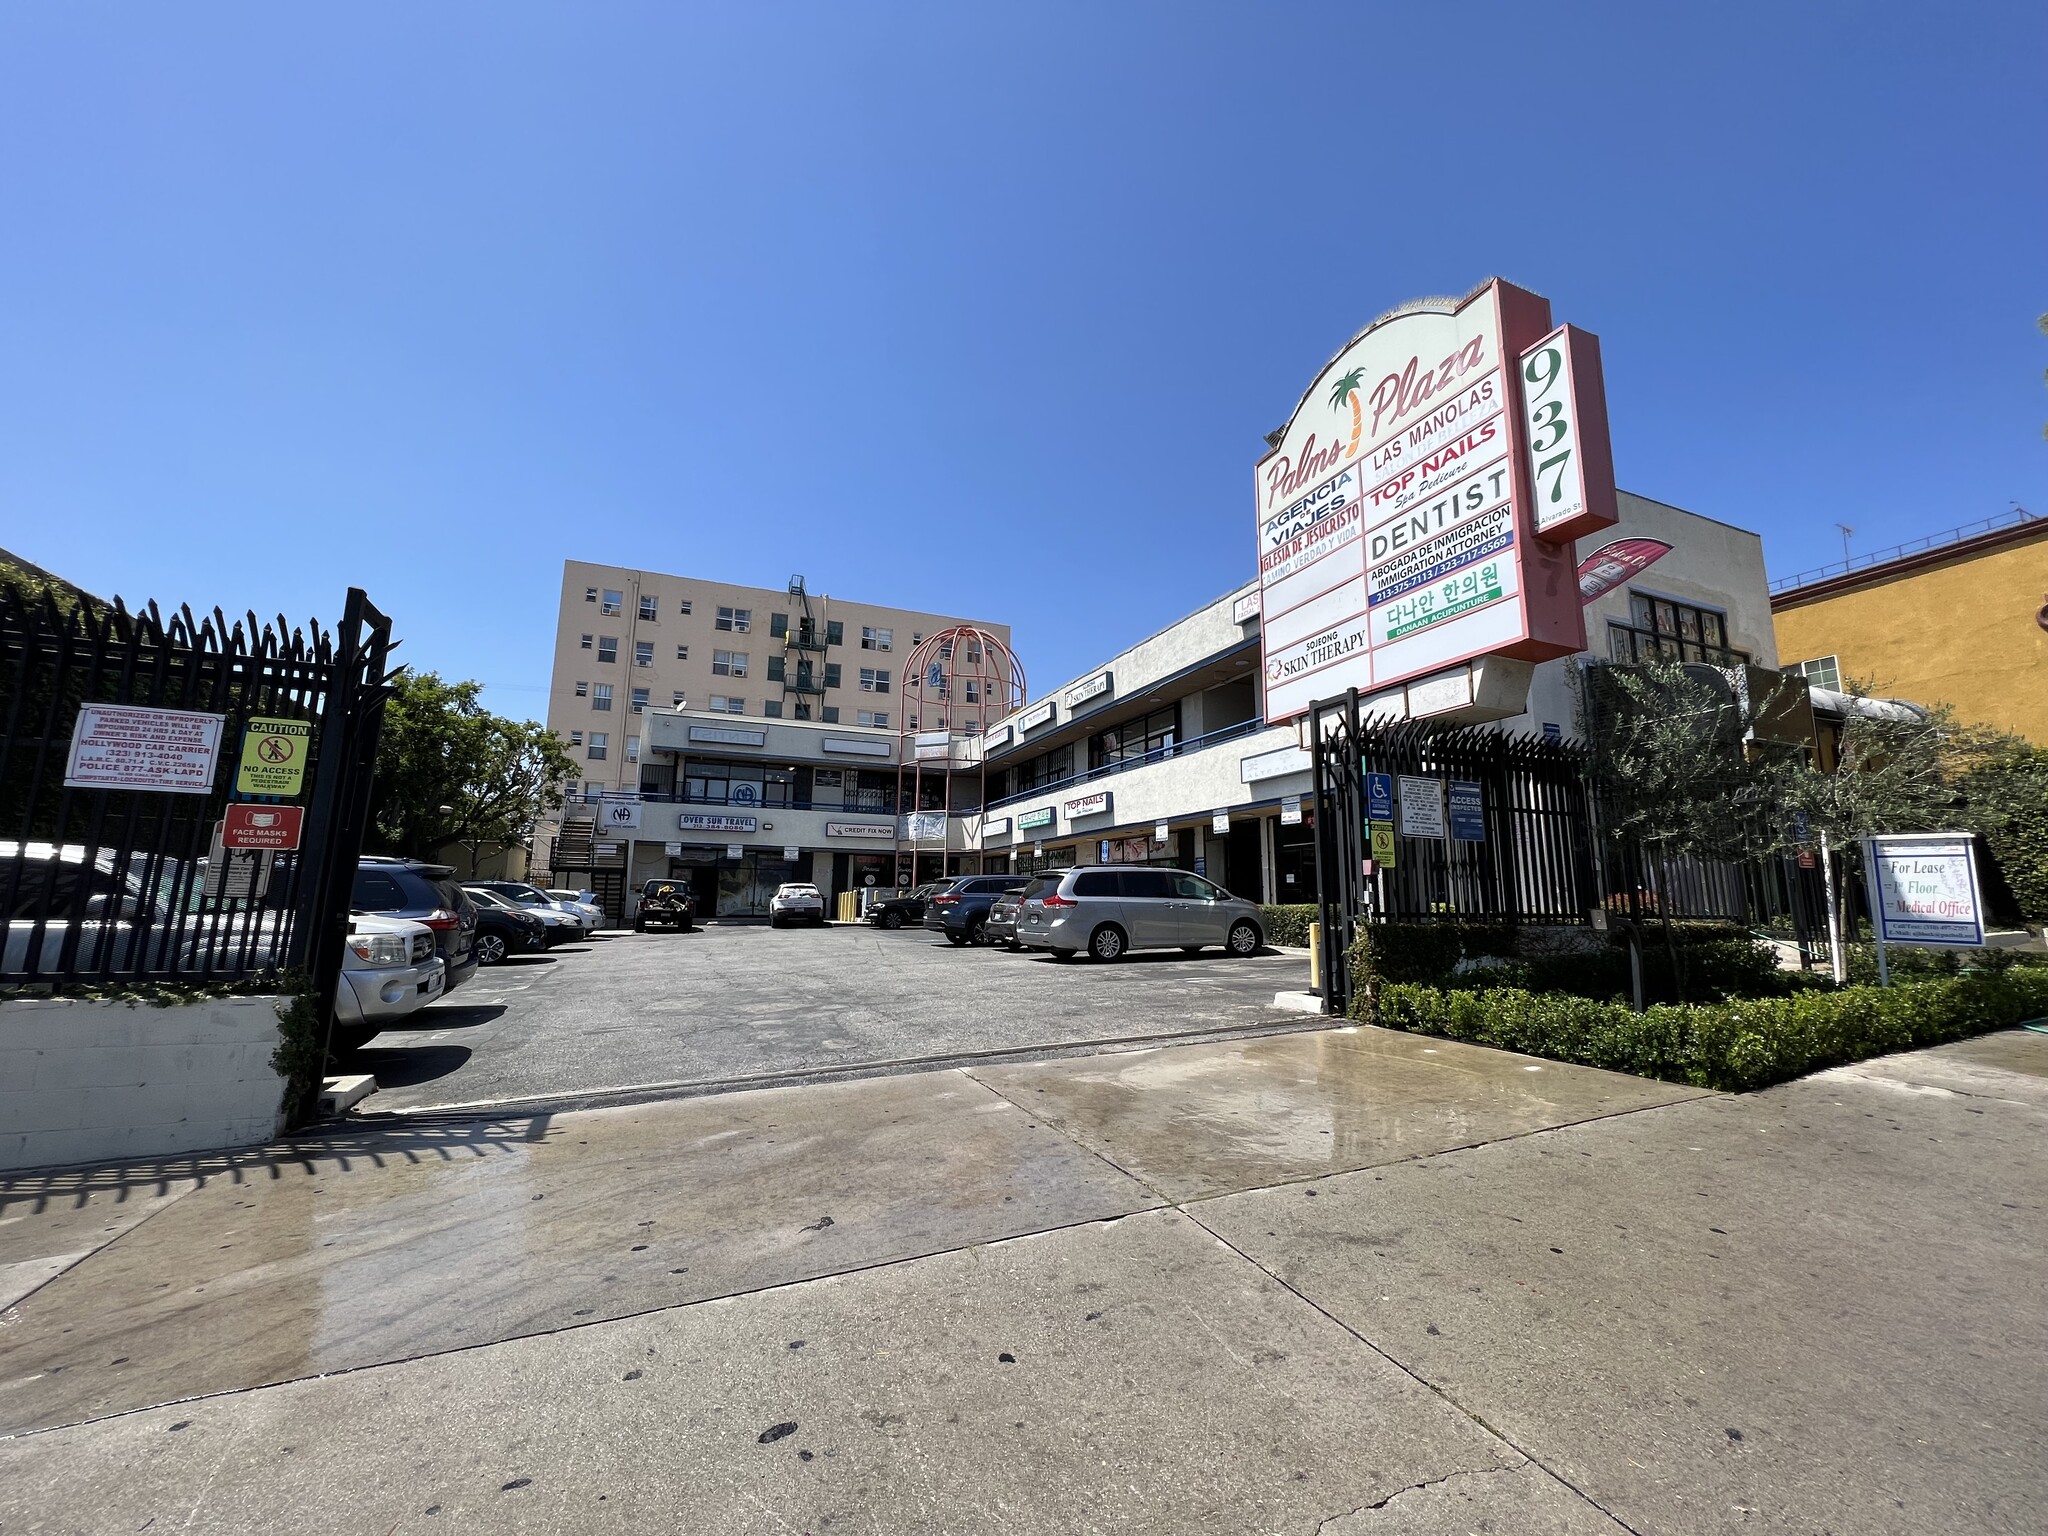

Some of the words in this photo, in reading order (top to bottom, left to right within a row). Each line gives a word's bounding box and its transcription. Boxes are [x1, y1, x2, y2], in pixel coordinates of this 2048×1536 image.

[1267, 433, 1346, 509] Palms
[1368, 334, 1484, 438] Plaza
[1374, 440, 1402, 471] LAS
[1409, 380, 1493, 448] MANOLAS
[1525, 348, 1572, 503] 937
[1375, 451, 1410, 482] SALON
[1418, 437, 1435, 454] DE
[1438, 398, 1499, 439] BELLEZA
[1370, 471, 1415, 507] TOP
[1422, 421, 1496, 479] NAILS
[1394, 492, 1415, 510] Spa
[1419, 461, 1468, 496] Pedicure
[1265, 473, 1352, 536] AGENCIA
[1300, 508, 1311, 519] DE
[1272, 494, 1346, 546] VIAJES
[1372, 468, 1506, 561] DENTIST
[1541, 506, 1572, 525] Alvarado
[1261, 544, 1291, 573] IGLESIA
[1292, 536, 1302, 555] DE
[1304, 503, 1360, 549] JESUCRISTO
[1294, 543, 1327, 569] VERDAD
[1328, 538, 1334, 550] Y
[1337, 526, 1356, 544] VIDA
[1372, 551, 1418, 581] ABOGADA
[1420, 546, 1433, 558] DE
[1434, 505, 1510, 552] INMIGRACION
[1378, 552, 1443, 590] IMMIGRATION
[1445, 522, 1504, 557] ATTORNEY
[1376, 569, 1433, 602] 213-375-7113
[1440, 535, 1507, 573] 323-717-6569
[1387, 590, 1435, 626] 다나안
[1442, 562, 1499, 604] 한의원
[1396, 618, 1429, 636] DANAAN
[1431, 594, 1490, 623] ACUPUNTURE
[1306, 631, 1338, 651] SOJEONG
[1284, 654, 1309, 677] SKIN
[1310, 630, 1366, 667] THERAPY
[91, 709, 150, 719] UNAUTHORIZED
[166, 715, 214, 725] IMPROPERLY
[132, 719, 169, 728] VEHICLES
[94, 723, 140, 732] IMPOUNDED
[94, 730, 128, 738] OWNER'S
[168, 735, 202, 744] EXPENSE
[251, 722, 307, 736] CAUTION
[81, 739, 142, 750] HOLLYWOOD
[145, 743, 164, 751] CAR
[169, 746, 210, 754] CARRIER
[134, 751, 182, 760] 913-4040
[80, 762, 120, 772] POLICE
[124, 765, 203, 776] 877-ASK-LAPD
[244, 765, 258, 773] NO
[262, 766, 300, 776] ACCESS
[1067, 801, 1080, 810] TOP
[1082, 795, 1104, 807] NAILS
[1451, 796, 1481, 806] ACCESS
[684, 816, 704, 825] OVER
[706, 817, 723, 825] SUN
[725, 818, 752, 826] TRAVEL
[238, 837, 282, 845] REQUIRED
[1892, 861, 1910, 874] For
[1914, 861, 1945, 874] Lease
[1908, 881, 1938, 894] Floor
[1896, 900, 1935, 914] Medical
[1939, 900, 1970, 918] Office
